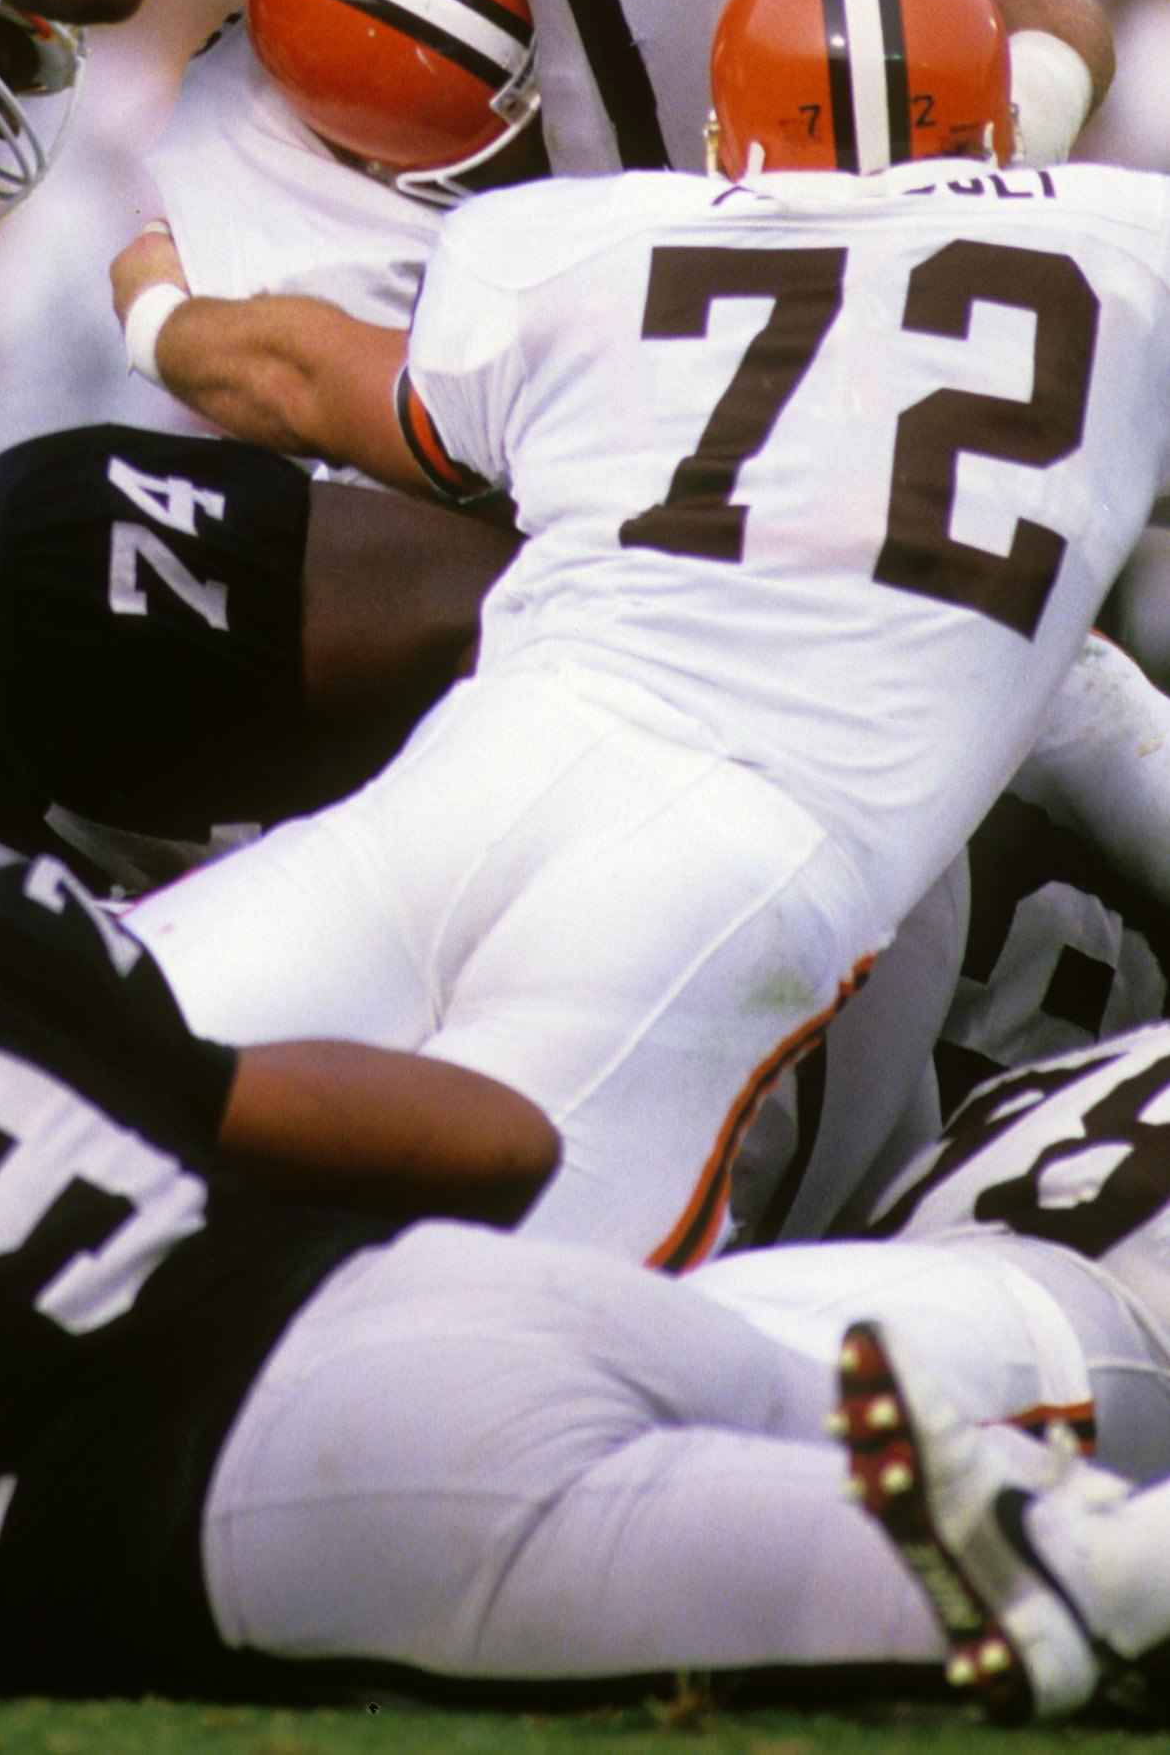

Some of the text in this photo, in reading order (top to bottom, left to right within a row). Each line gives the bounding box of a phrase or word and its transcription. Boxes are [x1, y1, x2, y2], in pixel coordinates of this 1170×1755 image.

[913, 93, 936, 128] 2
[619, 239, 1101, 644] 72
[110, 457, 226, 632] 74
